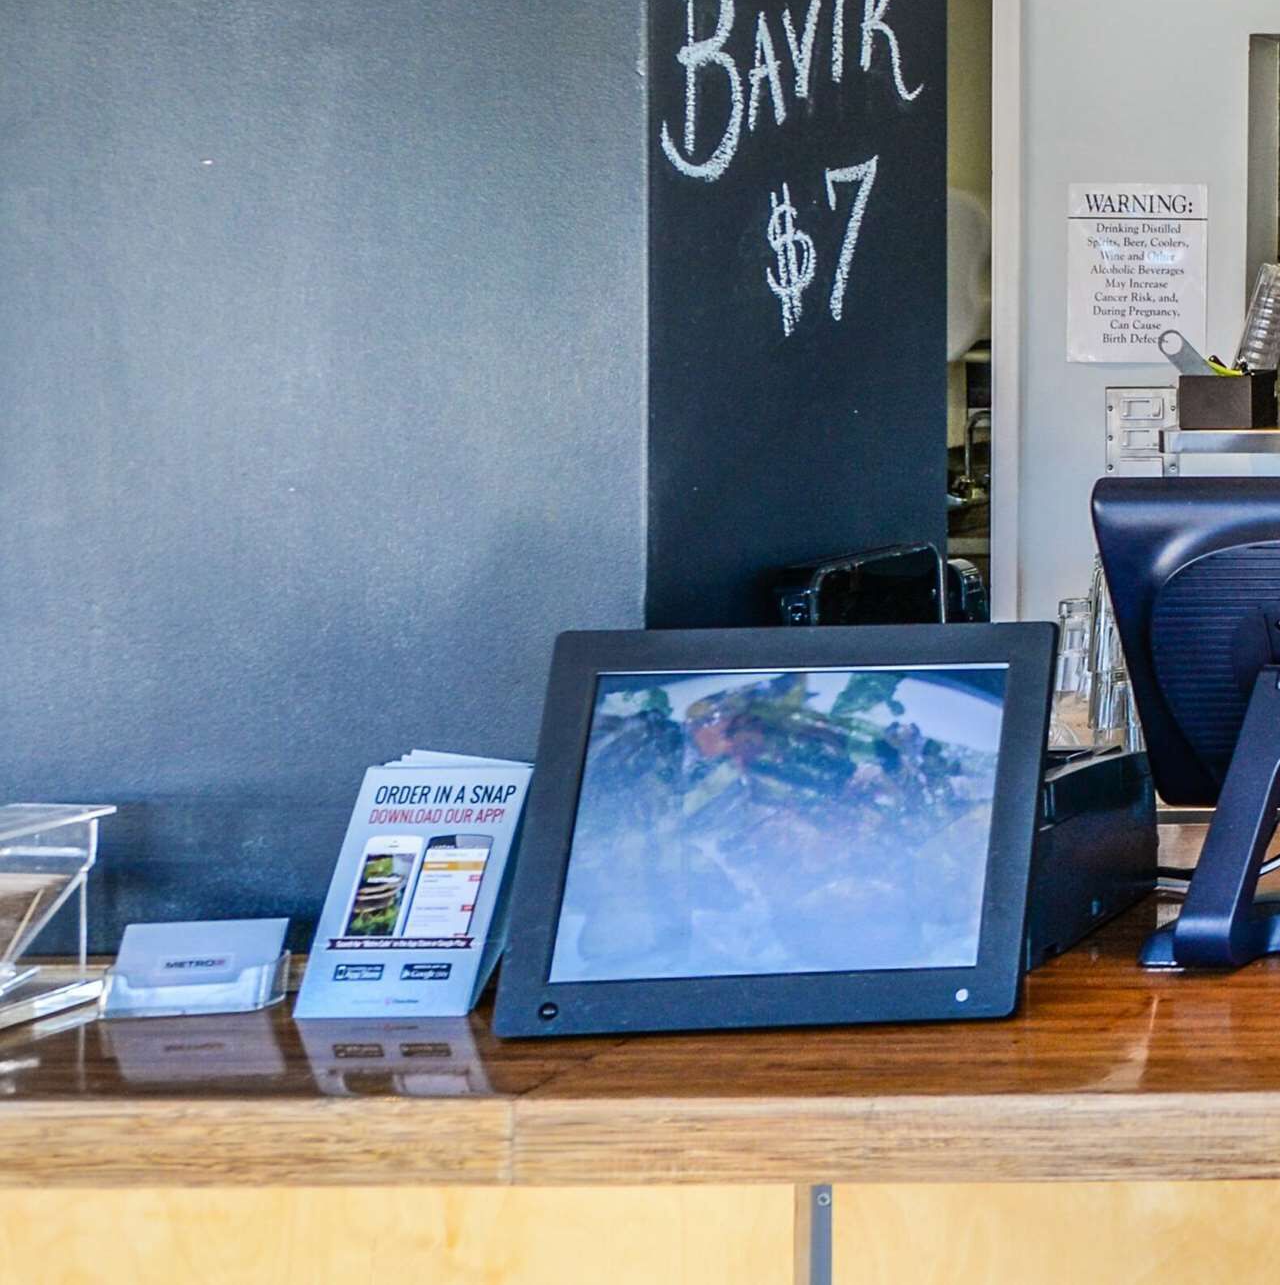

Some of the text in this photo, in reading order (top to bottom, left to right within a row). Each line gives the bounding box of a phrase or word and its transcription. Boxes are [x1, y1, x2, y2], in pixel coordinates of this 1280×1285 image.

[1085, 194, 1193, 214] WARNING:
[1096, 223, 1181, 234] Drinking Distilled
[1124, 238, 1147, 247] Beer,
[1127, 252, 1144, 261] and
[1090, 265, 1184, 276] Alcoholic Beverages
[1105, 279, 1168, 289] May Increase
[1094, 293, 1179, 303] Cancer Risk, and,
[1093, 306, 1180, 317] During Pregnancy,
[1110, 320, 1161, 330] Can Cause
[1102, 334, 1126, 343] Birth
[375, 785, 516, 805] ORDER IN A SNAP
[368, 808, 505, 824] DOWNLOAD OUR APP!
